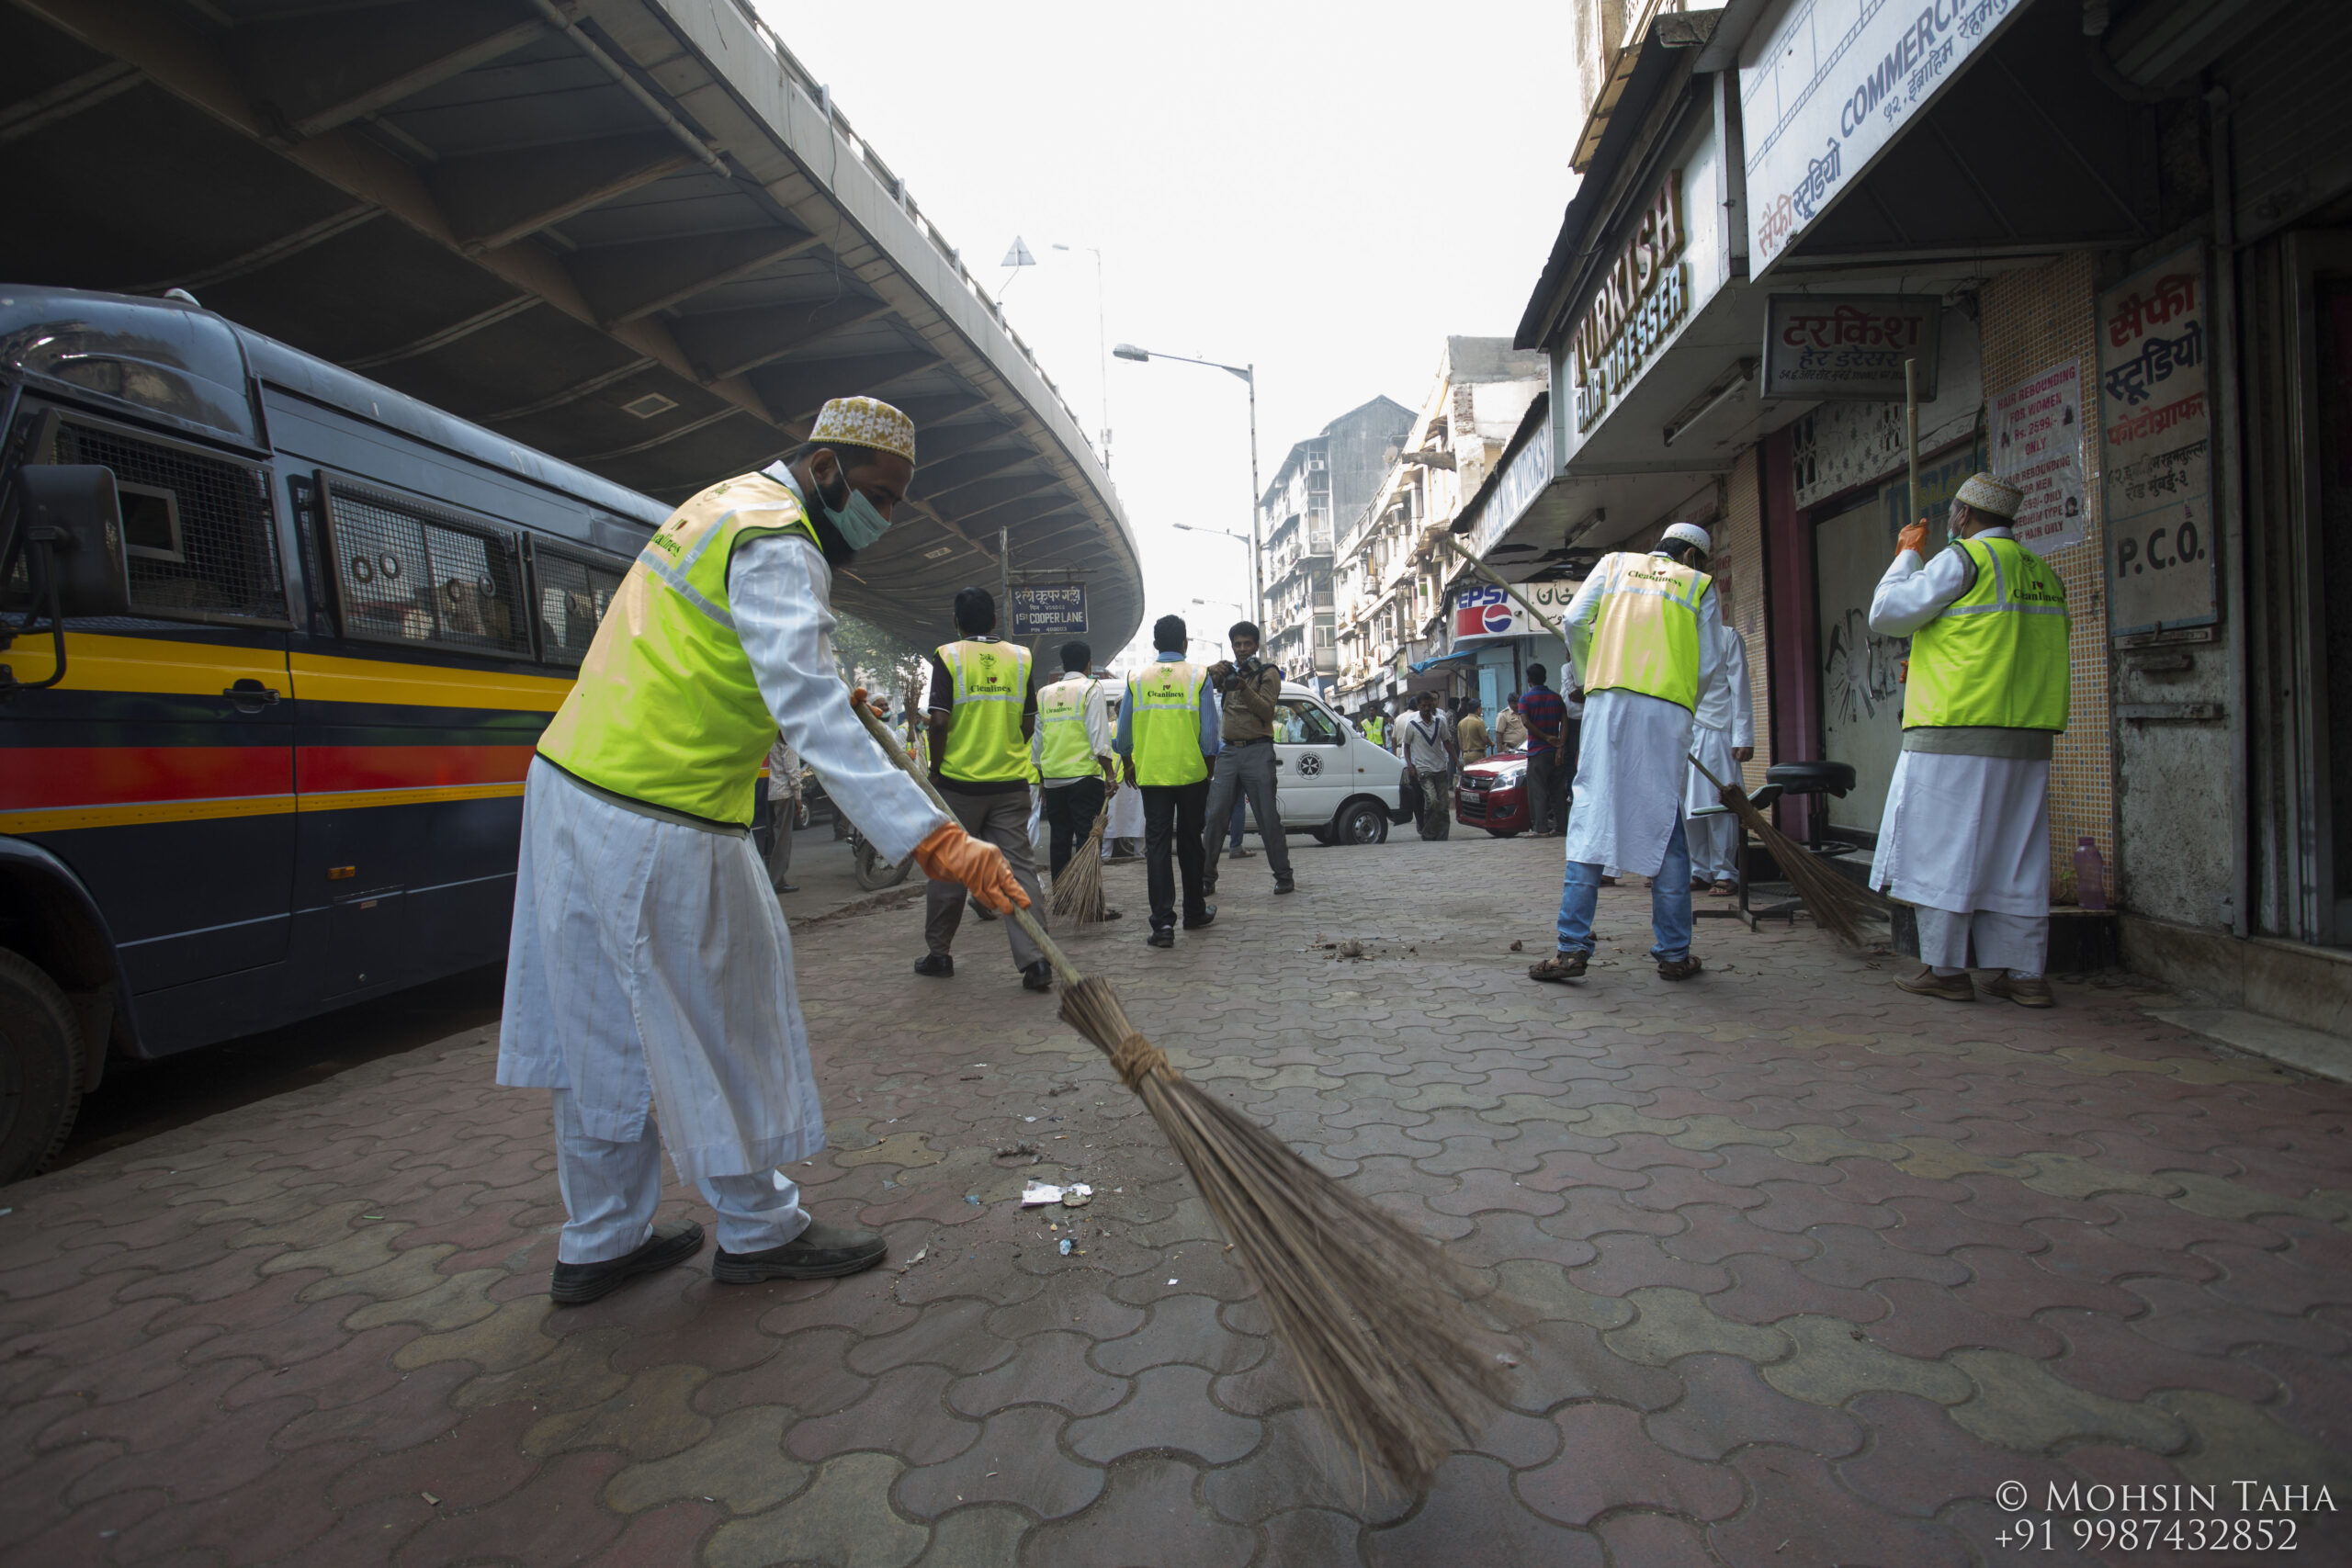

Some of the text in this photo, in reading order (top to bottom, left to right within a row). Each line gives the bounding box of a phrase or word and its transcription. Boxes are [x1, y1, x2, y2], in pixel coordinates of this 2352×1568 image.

[1841, 0, 1966, 138] COMMERC
[1570, 169, 1684, 388] TURKISH
[2109, 274, 2195, 347] सैफी
[1576, 263, 1688, 434] HAIR DRESSER
[2105, 321, 2202, 405] स्टूडियो
[1997, 367, 2075, 412] HAIR REBOUNDING
[2010, 392, 2062, 423] FOR WOMEN
[2025, 438, 2046, 456] ONLY
[1514, 428, 1545, 507] WORKS
[2022, 456, 2071, 480] REBOUNDING
[2036, 477, 2052, 491] MEN
[2044, 488, 2064, 504] ONLY
[2044, 505, 2064, 520] TYPE
[2025, 525, 2042, 540] HAIR
[2045, 521, 2064, 536] ONLY
[2118, 522, 2205, 578] P.C.O.
[1628, 570, 1681, 587] Cleanliness
[2032, 581, 2037, 590] I
[1030, 612, 1059, 624] COOPER
[1061, 612, 1083, 623] LANE
